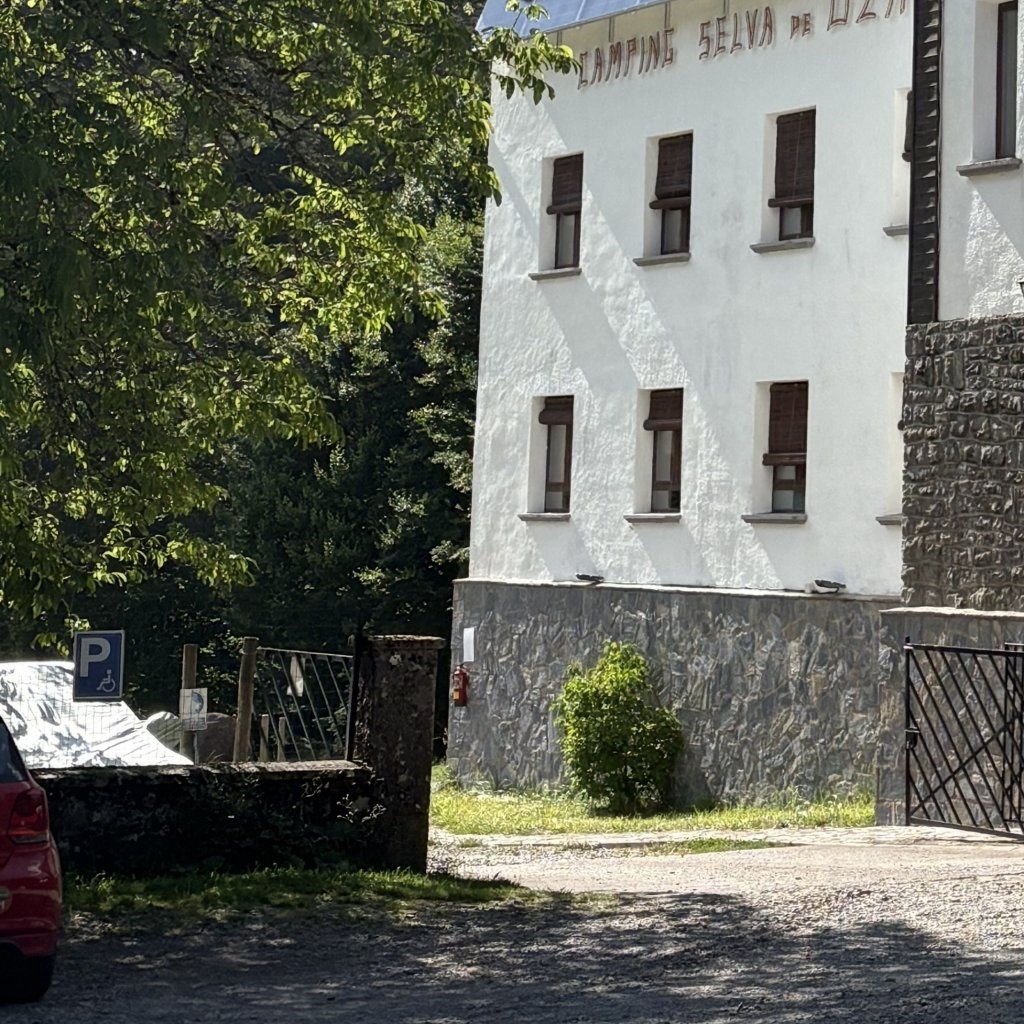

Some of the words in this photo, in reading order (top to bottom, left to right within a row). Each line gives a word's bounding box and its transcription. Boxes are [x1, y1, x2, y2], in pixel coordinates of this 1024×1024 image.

[577, 28, 674, 90] CAMPING
[699, 7, 773, 60] SELVA
[790, 13, 811, 40] DE
[80, 637, 111, 677] P
